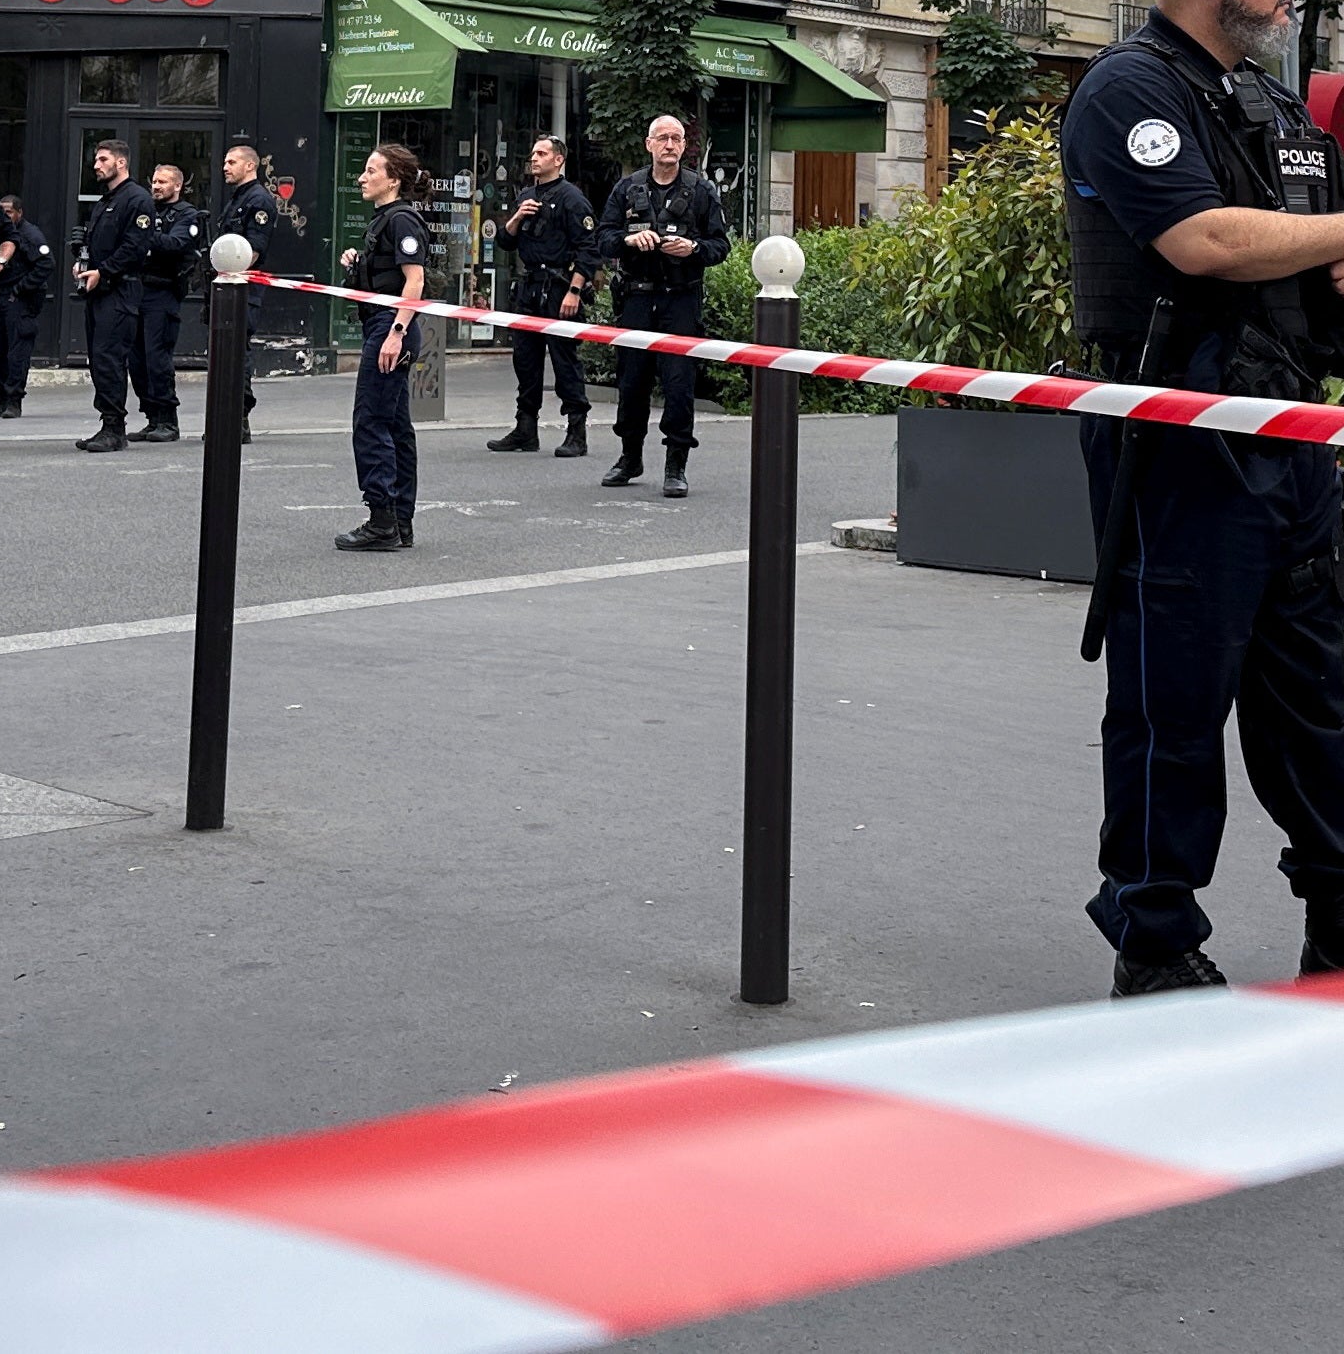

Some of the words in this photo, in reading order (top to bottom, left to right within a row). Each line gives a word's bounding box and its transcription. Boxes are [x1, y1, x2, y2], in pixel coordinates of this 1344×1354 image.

[453, 13, 465, 26] 23
[466, 14, 478, 26] 56
[514, 25, 537, 46] A
[537, 27, 555, 49] la
[560, 30, 608, 54] Collin
[344, 83, 425, 106] Fleuriste
[1278, 149, 1326, 167] POLICE
